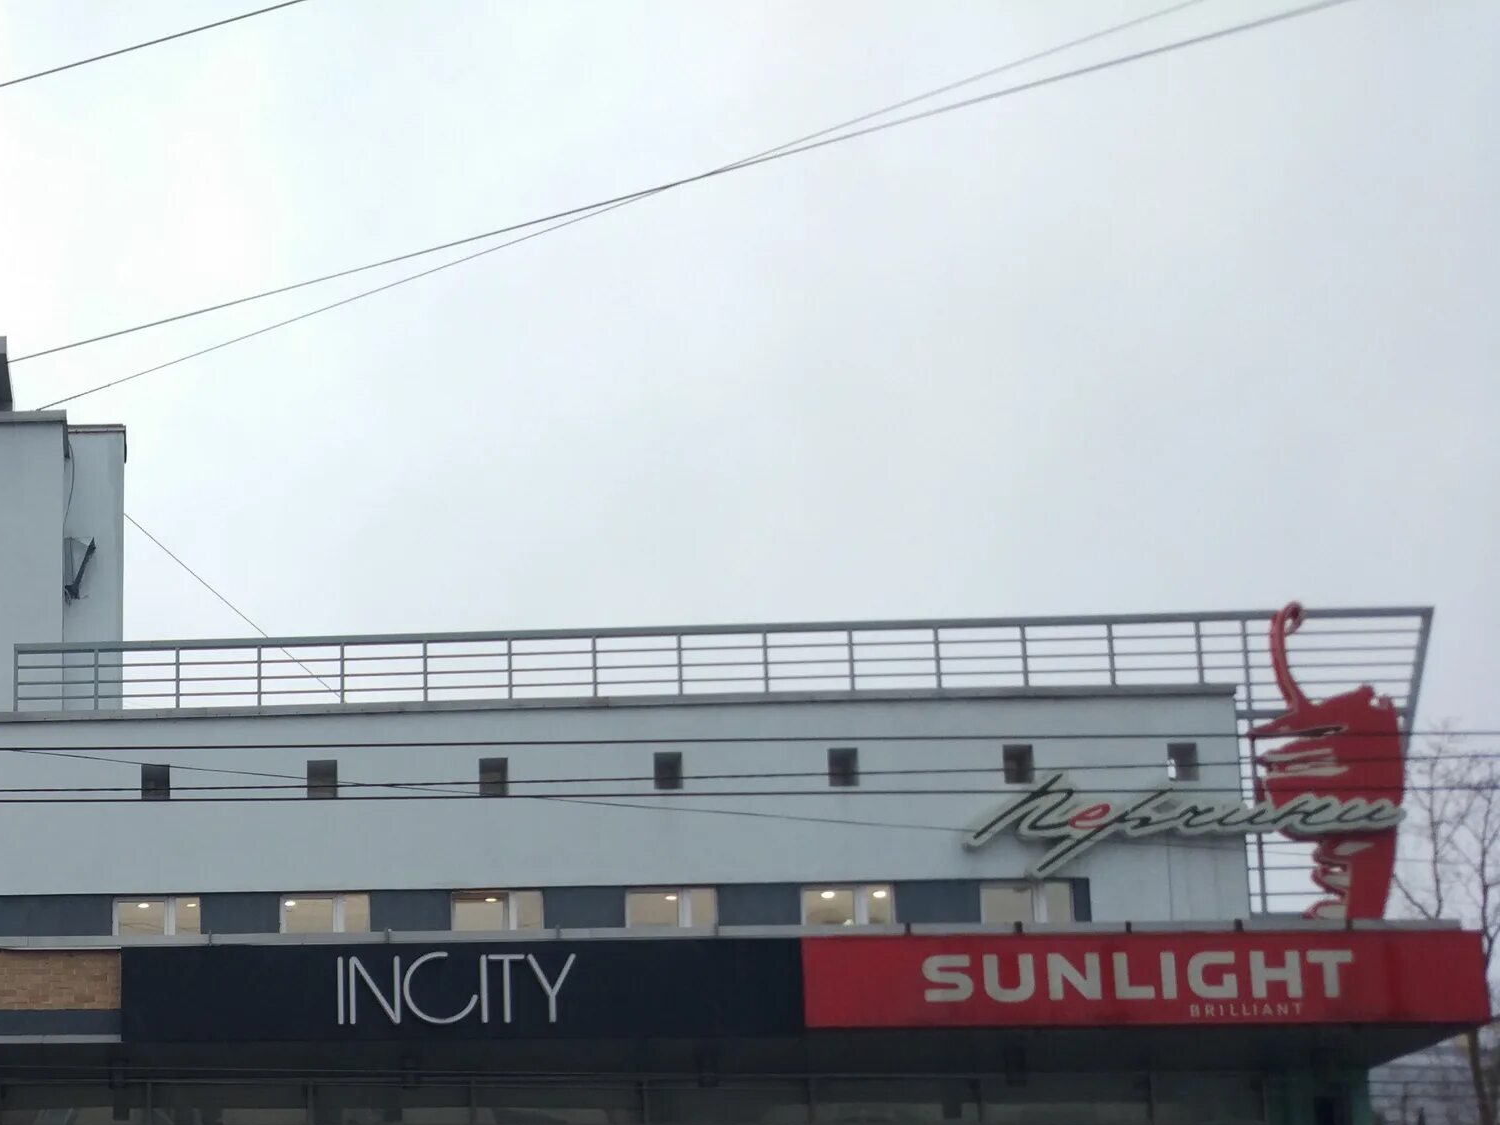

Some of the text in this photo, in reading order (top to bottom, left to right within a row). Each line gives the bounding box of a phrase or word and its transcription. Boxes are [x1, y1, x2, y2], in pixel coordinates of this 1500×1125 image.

[337, 951, 577, 1025] INCITY
[921, 949, 1355, 1002] SUNLIGHT
[1189, 1003, 1303, 1018] BRILLIANT
